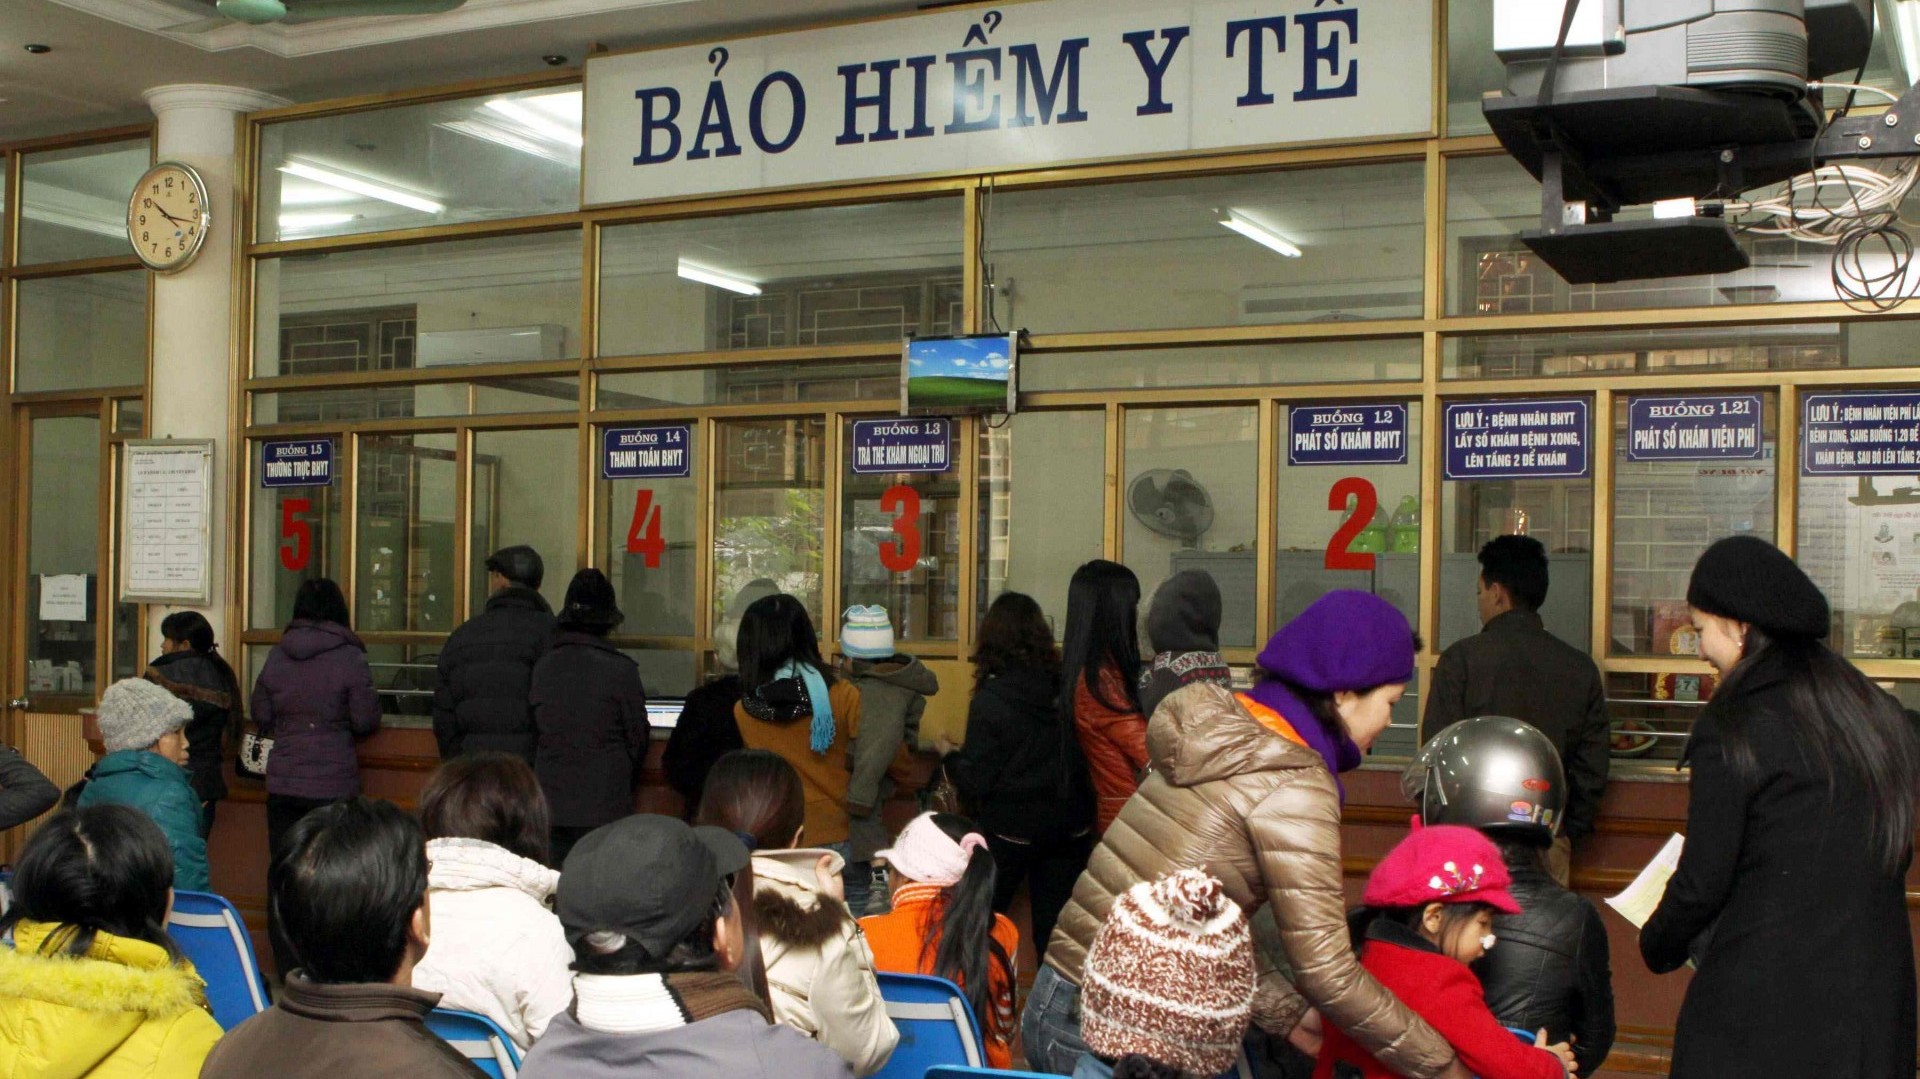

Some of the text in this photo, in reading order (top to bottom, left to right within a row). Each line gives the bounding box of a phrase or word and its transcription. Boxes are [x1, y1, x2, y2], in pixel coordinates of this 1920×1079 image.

[633, 47, 806, 166] BẢO
[835, 10, 1089, 145] HIỂM
[1122, 26, 1190, 116] Y
[164, 177, 174, 188] 12
[181, 181, 185, 191] 1
[152, 184, 159, 195] 11
[143, 198, 152, 209] 10
[189, 192, 195, 203] 2
[139, 215, 146, 226] 9
[192, 209, 199, 220] 3
[142, 231, 149, 242] 8
[188, 226, 195, 236] 4
[152, 243, 158, 253] 7
[165, 247, 172, 257] 6
[179, 240, 185, 251] 5
[1720, 401, 1750, 414] 1.21
[1832, 402, 1839, 421] Ý
[1844, 404, 1862, 424] BỆNH
[1900, 403, 1911, 420] PHÍ
[1374, 410, 1393, 424] 1.2
[1476, 409, 1483, 427] Ý
[1492, 412, 1518, 430] BỆNH
[1520, 410, 1548, 426] NHÂN
[1550, 412, 1575, 426] BHYT
[924, 422, 940, 435] 1.3
[666, 430, 680, 443] 1.4
[1295, 426, 1401, 451] PHÁT SỐ KHÁM BHYT
[1455, 431, 1581, 449] LẤY SỐ KHÁM BỆNH XONG,
[1635, 422, 1755, 453] PHÁT SỐ KHÁM VIỆN PHÍ
[1850, 429, 1869, 442] SANG
[610, 447, 683, 468] THANH TOÁN BHYT
[858, 437, 945, 468] TRẢ THẺ KHÁM NGOẠI TRÚ
[1465, 452, 1483, 468] LÊN
[1513, 454, 1520, 466] 2
[1537, 450, 1567, 466] KHÁM
[1815, 448, 1835, 465] KHÁM
[1857, 451, 1871, 465] SAU
[1882, 448, 1896, 464] LÊN
[311, 460, 329, 476] BHYT
[626, 489, 665, 569] 4
[879, 484, 921, 572] 3
[1324, 476, 1377, 570] 2
[280, 498, 312, 571] 5
